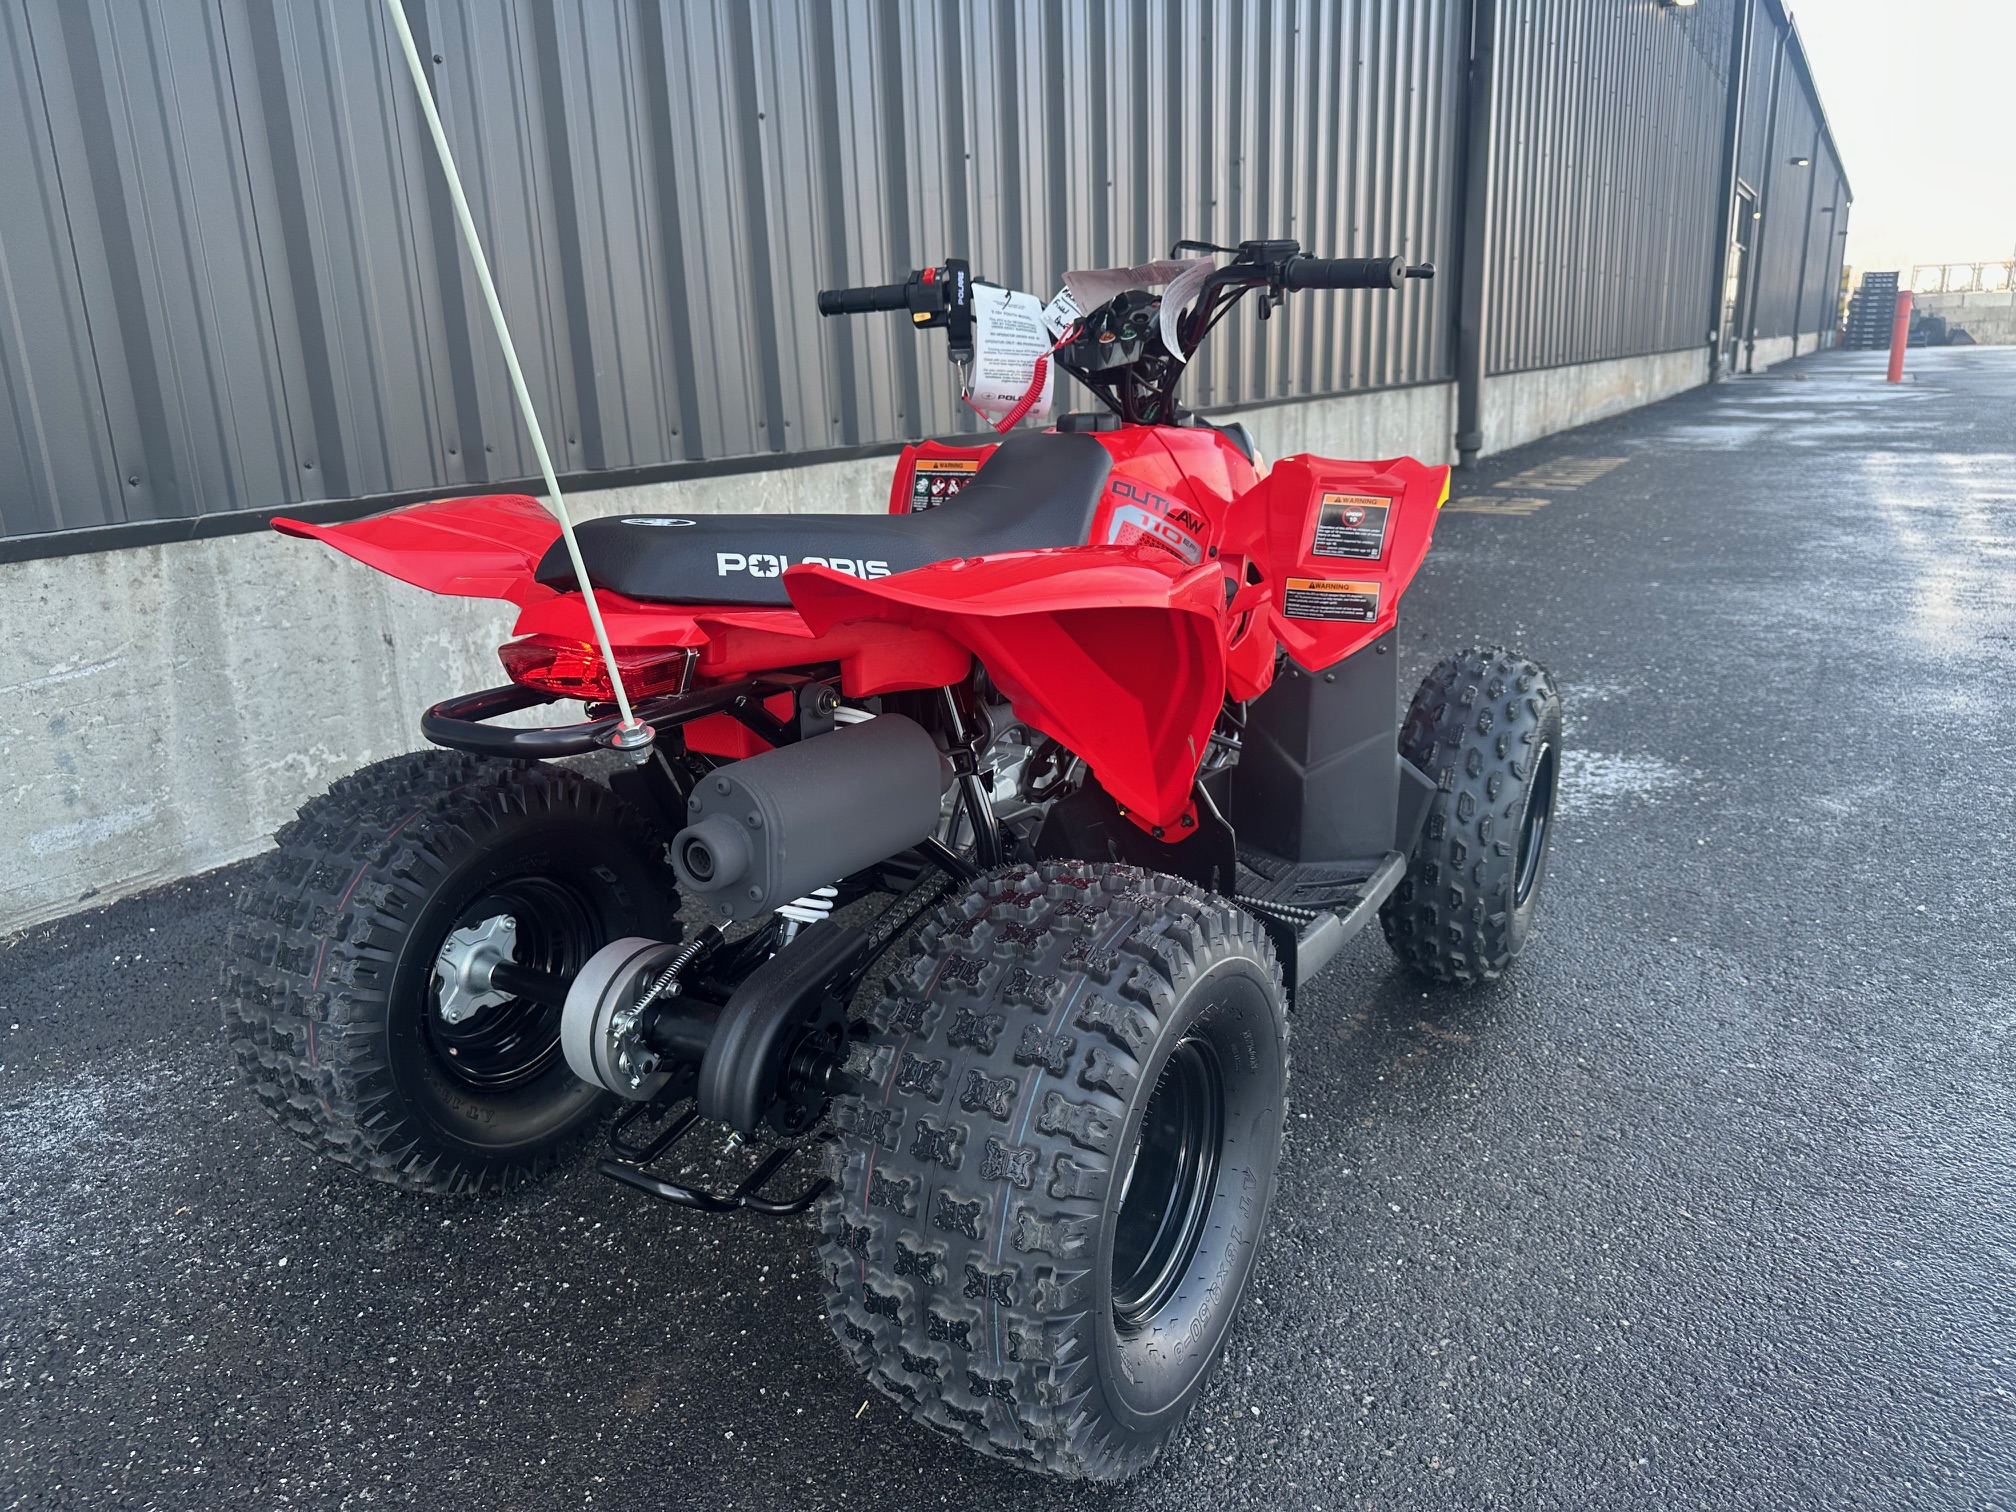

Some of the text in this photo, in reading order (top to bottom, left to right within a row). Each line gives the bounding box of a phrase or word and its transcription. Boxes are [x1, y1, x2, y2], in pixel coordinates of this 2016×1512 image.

[997, 394, 1042, 403] POLS
[1111, 480, 1206, 535] OUTLAW
[1342, 497, 1378, 505] WARNING
[1140, 513, 1183, 545] 110
[1314, 582, 1350, 590] WARNING
[1238, 1165, 1258, 1220] AT
